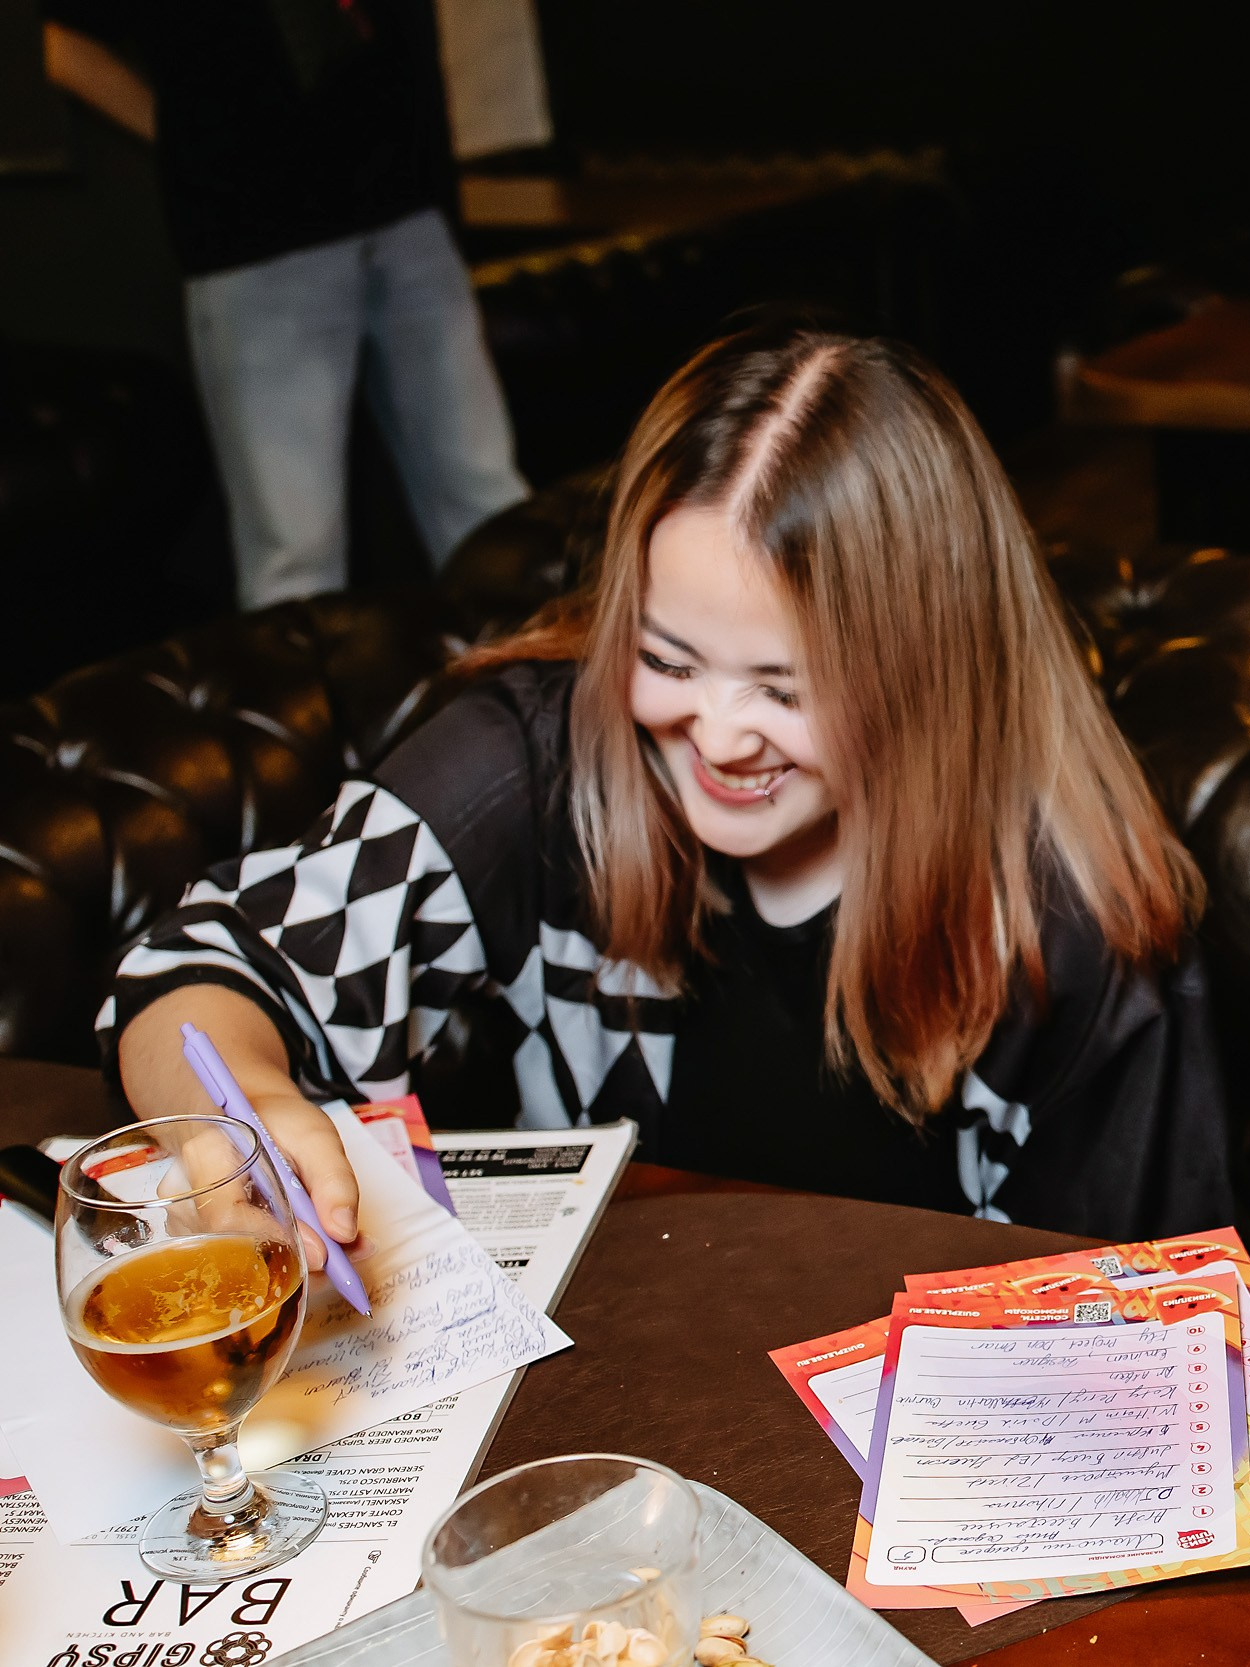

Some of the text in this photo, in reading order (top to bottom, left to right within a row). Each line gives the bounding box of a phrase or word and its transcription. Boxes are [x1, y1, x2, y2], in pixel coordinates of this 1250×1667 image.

[1168, 1245, 1220, 1260] #КВИЗПЛИЗ
[1162, 1292, 1217, 1307] #КВИЗПЛИЗ
[908, 1307, 980, 1317] QUIZPLEASE.RU
[796, 1343, 866, 1367] QUIZPLEASE.RU
[387, 1465, 424, 1473] SERENA
[360, 1476, 419, 1485] LAMBRUSCO
[373, 1487, 414, 1495] MARTINI
[361, 1498, 409, 1506] ASKANELI
[338, 1521, 384, 1529] SANCHES
[102, 1578, 292, 1626] BAR
[50, 1643, 195, 1667] GIPSY
